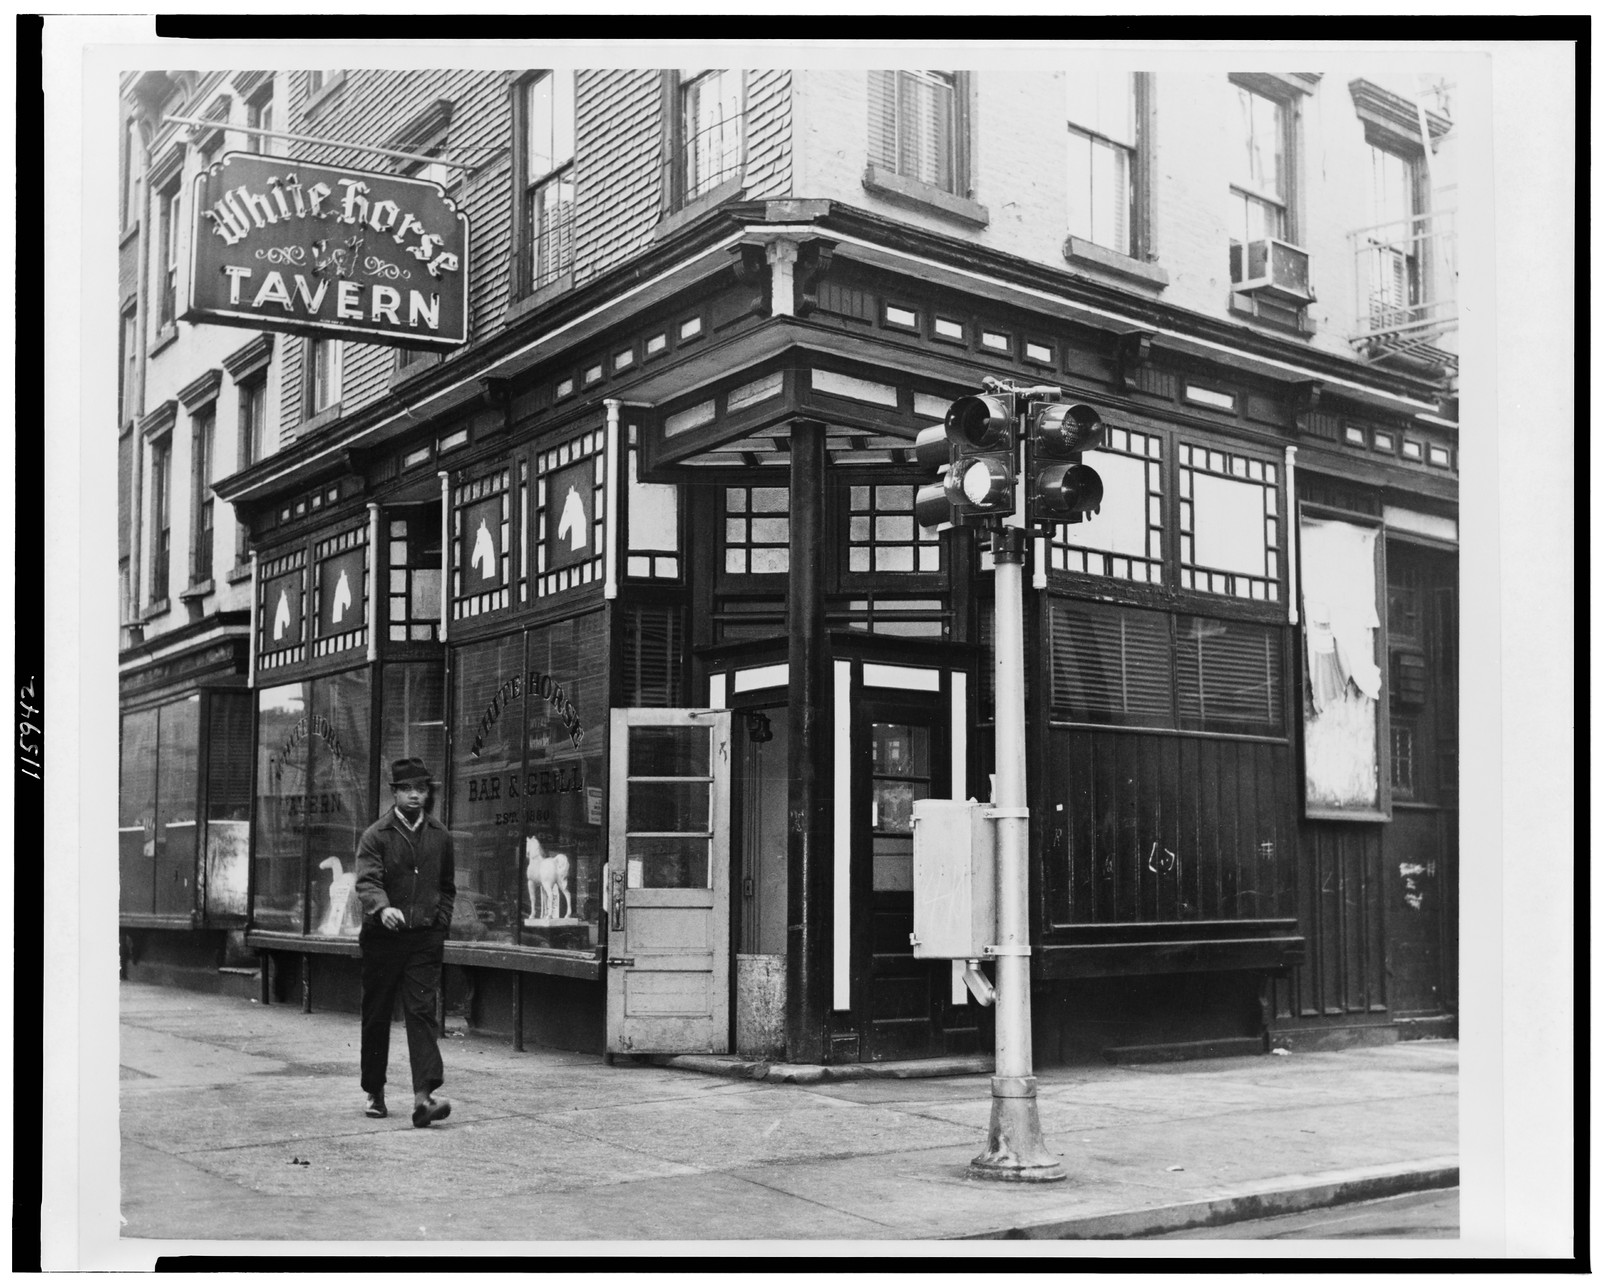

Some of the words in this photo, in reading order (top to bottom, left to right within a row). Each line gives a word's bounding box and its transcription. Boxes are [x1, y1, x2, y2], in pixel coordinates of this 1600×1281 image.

[201, 173, 331, 245] White
[223, 265, 439, 330] TAVERN
[471, 675, 521, 757] WHITE
[529, 671, 584, 749] HORSE
[469, 777, 501, 801] BAR
[509, 775, 519, 798] &
[527, 767, 583, 797] GRILL
